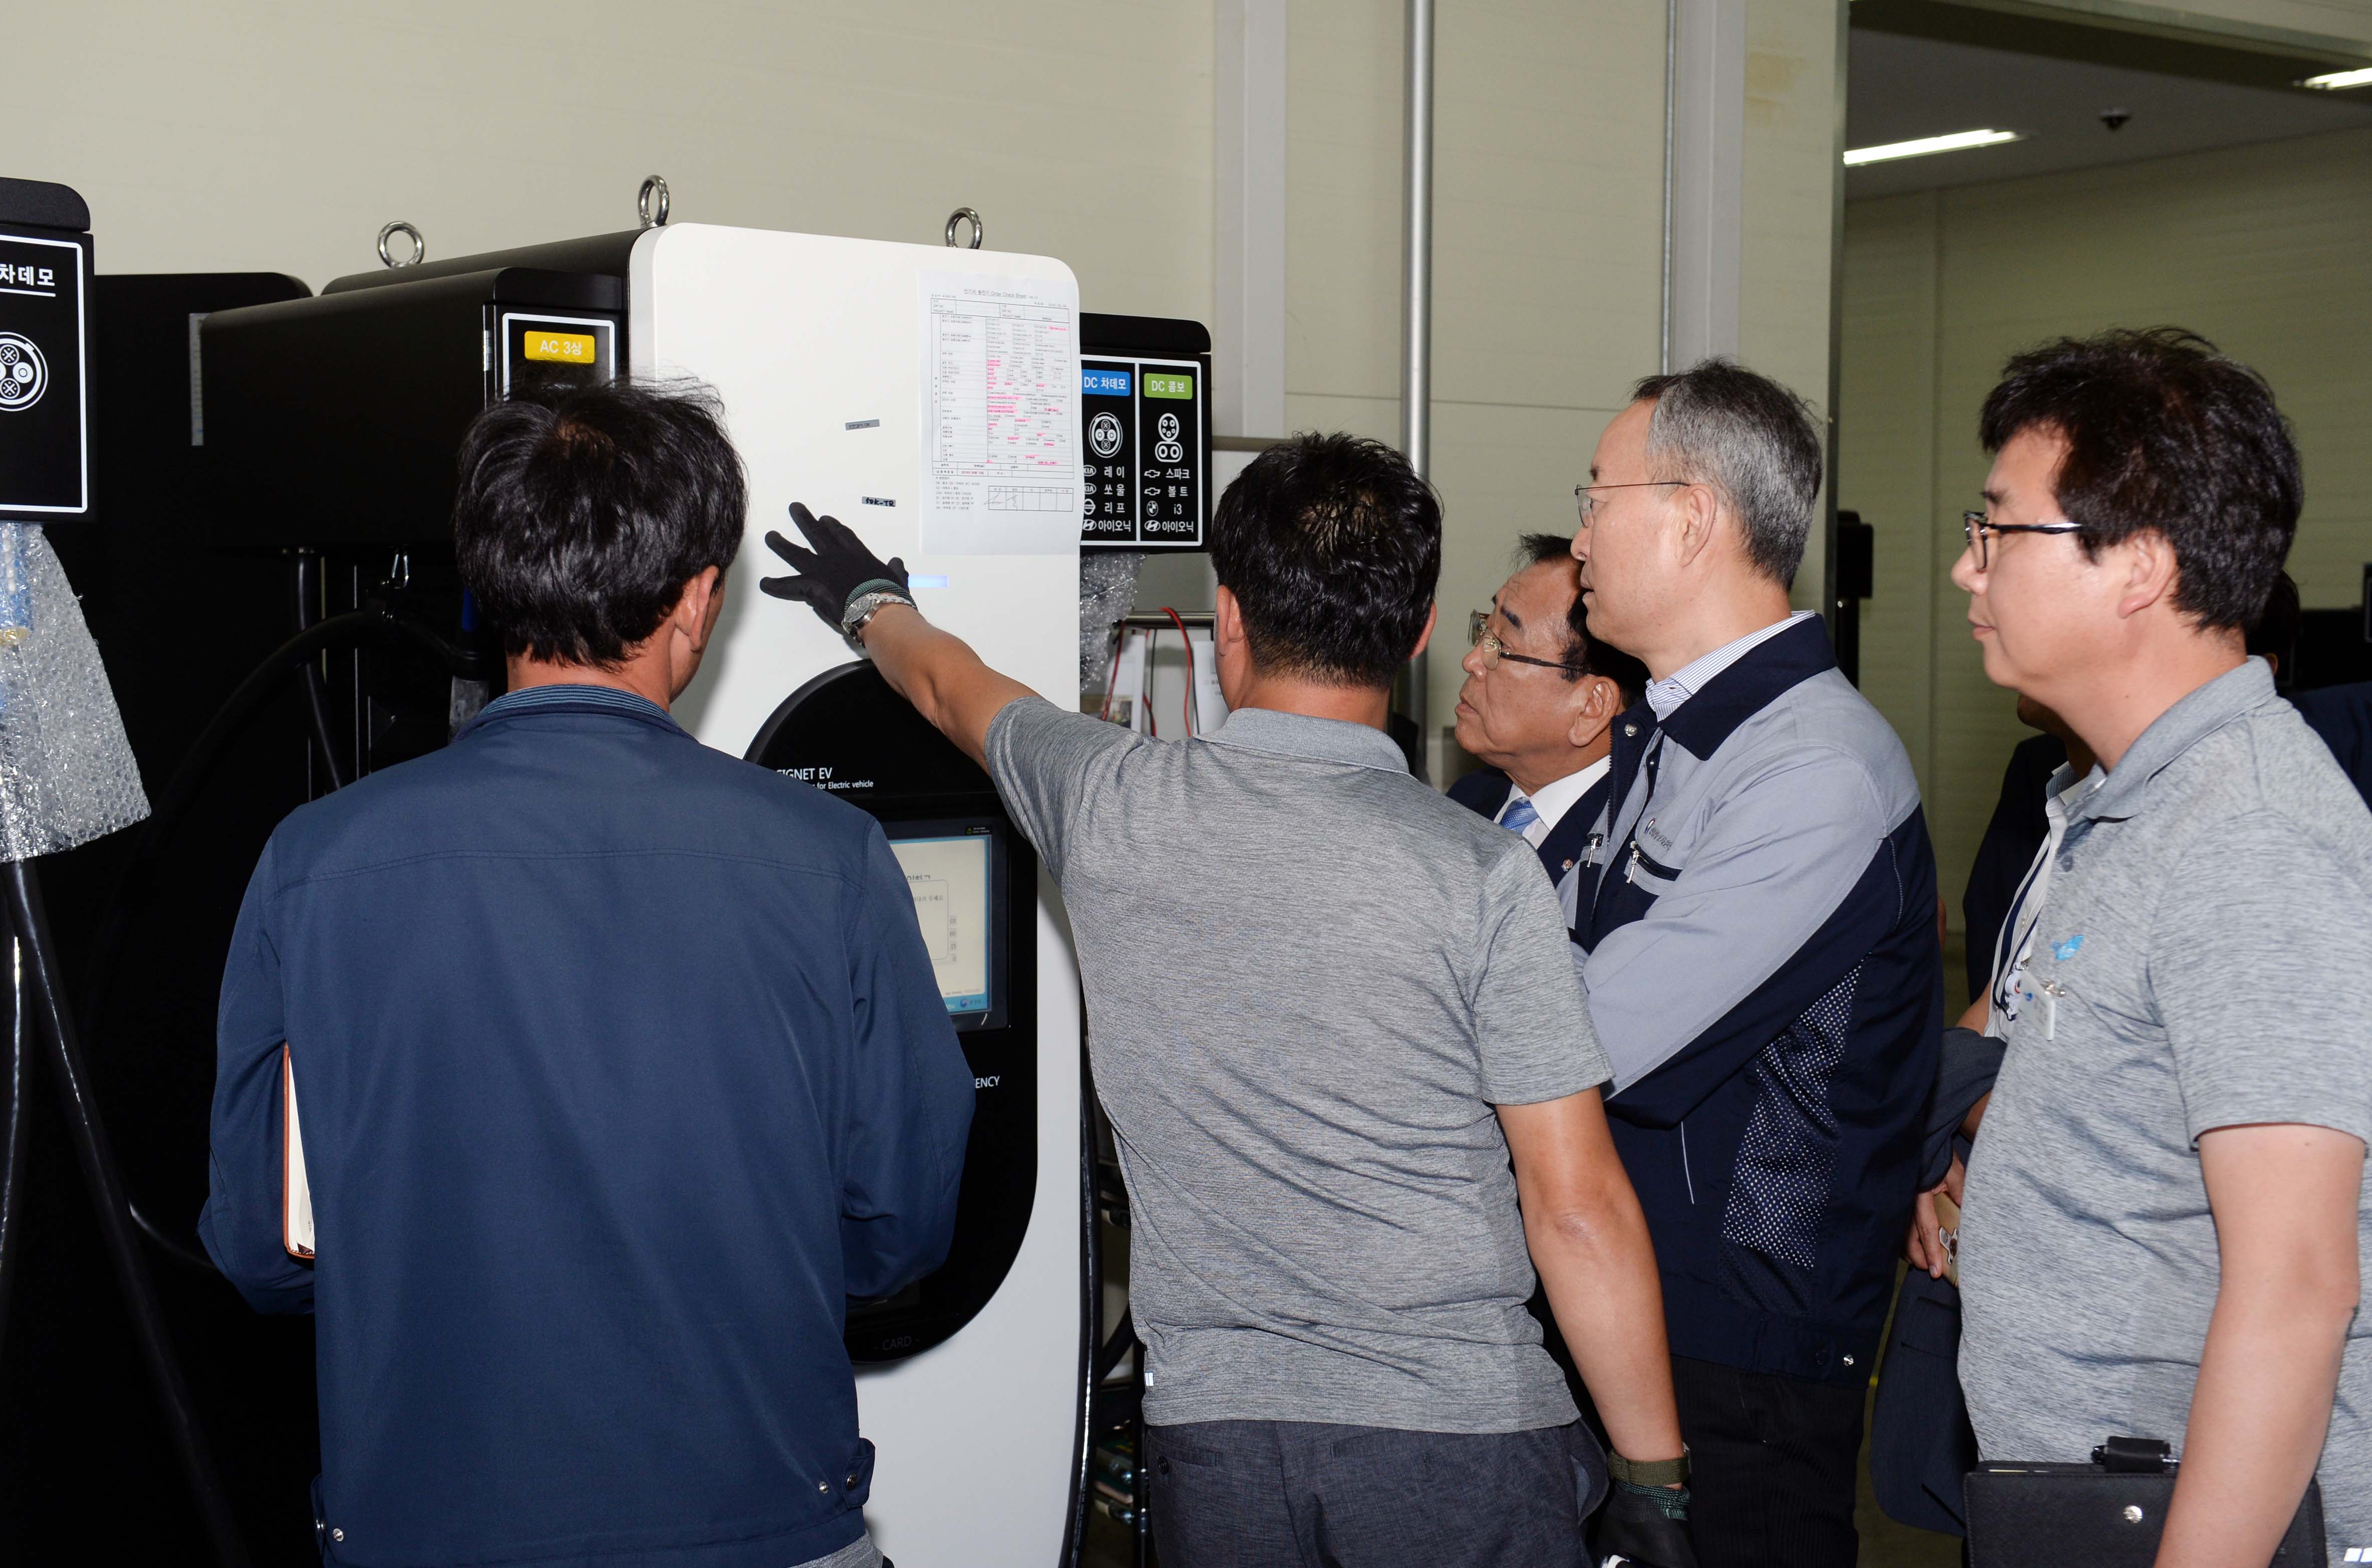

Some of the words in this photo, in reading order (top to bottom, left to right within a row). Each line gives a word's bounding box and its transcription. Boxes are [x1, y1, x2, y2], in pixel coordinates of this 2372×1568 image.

[0, 263, 55, 286] 차데모
[540, 340, 559, 353] AC
[563, 341, 582, 355] 3상
[1084, 376, 1098, 388] DC
[1101, 377, 1127, 390] 차데모
[1151, 380, 1165, 392] DC
[1168, 380, 1185, 393] 콤보
[1165, 467, 1191, 479] 스파크
[1173, 503, 1182, 515] i3
[1098, 519, 1131, 532] 아이오닉
[1162, 520, 1194, 533] 아이오닉
[777, 768, 815, 780] GNET
[819, 767, 833, 779] EV
[828, 780, 850, 789] Electric
[852, 779, 874, 789] vehicle
[975, 1075, 1000, 1089] ENCY
[882, 1335, 912, 1351] CARD
